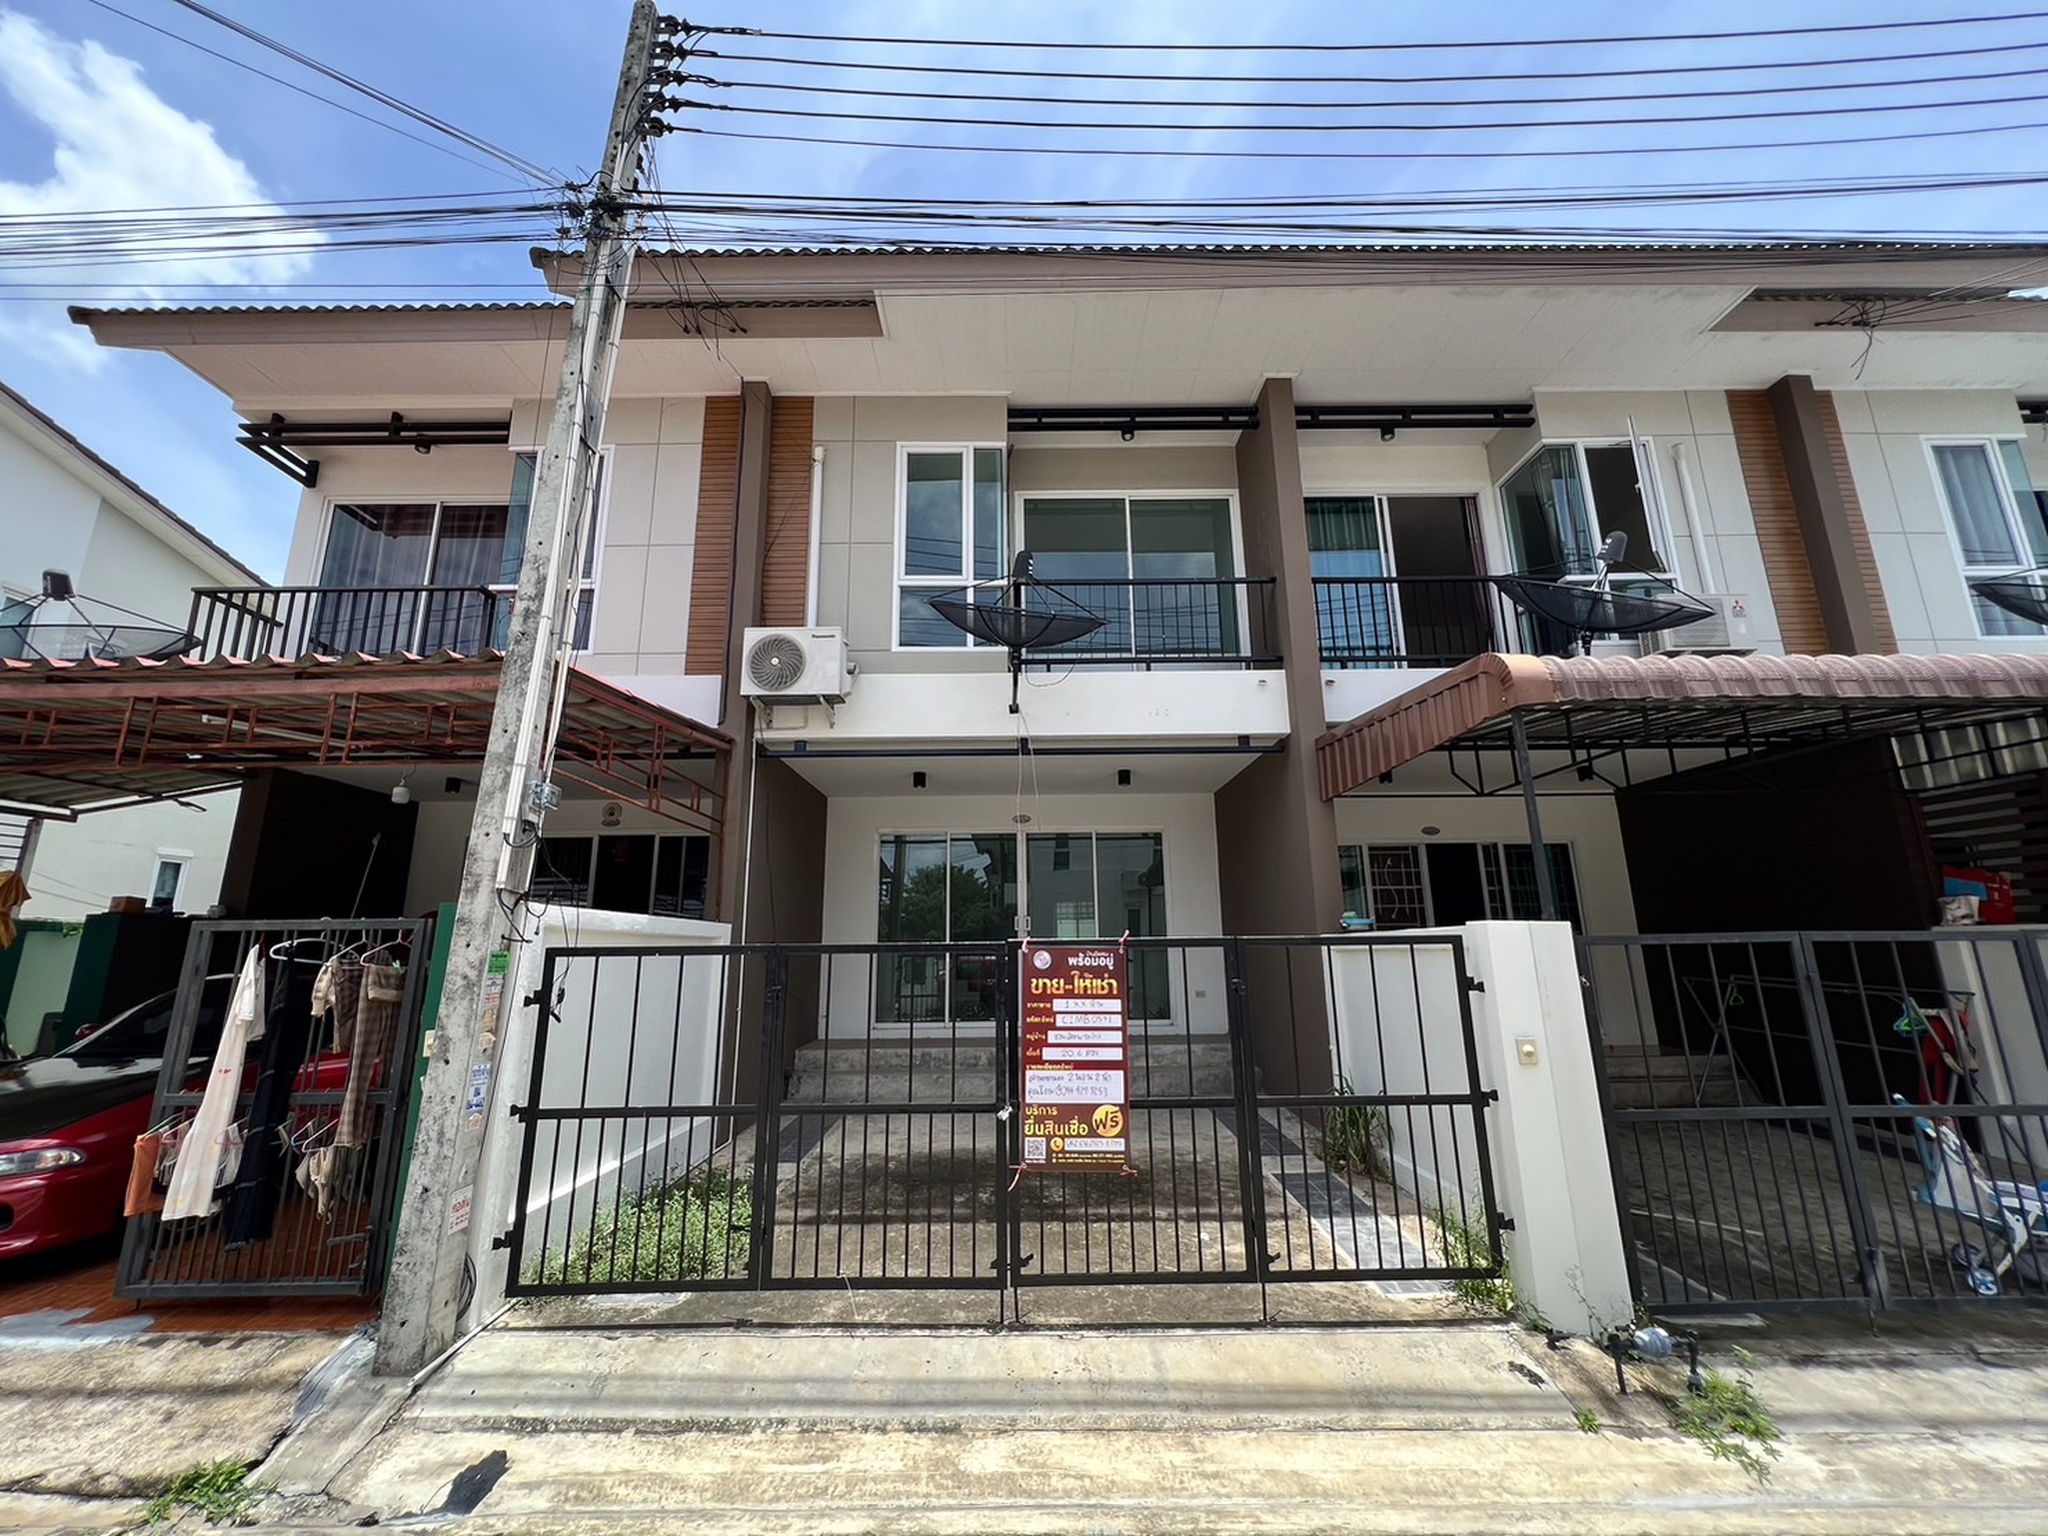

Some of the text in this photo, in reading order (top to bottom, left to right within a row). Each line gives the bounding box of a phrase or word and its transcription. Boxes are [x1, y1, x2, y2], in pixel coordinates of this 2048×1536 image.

[1068, 953, 1114, 970] พร้อมอยู่
[1031, 971, 1118, 995] ขาย-ให้เช่า
[1025, 1104, 1058, 1115] บริการ
[1094, 1106, 1120, 1131] ฟรี
[1024, 1116, 1088, 1136] ยื่นสินเชื่อ
